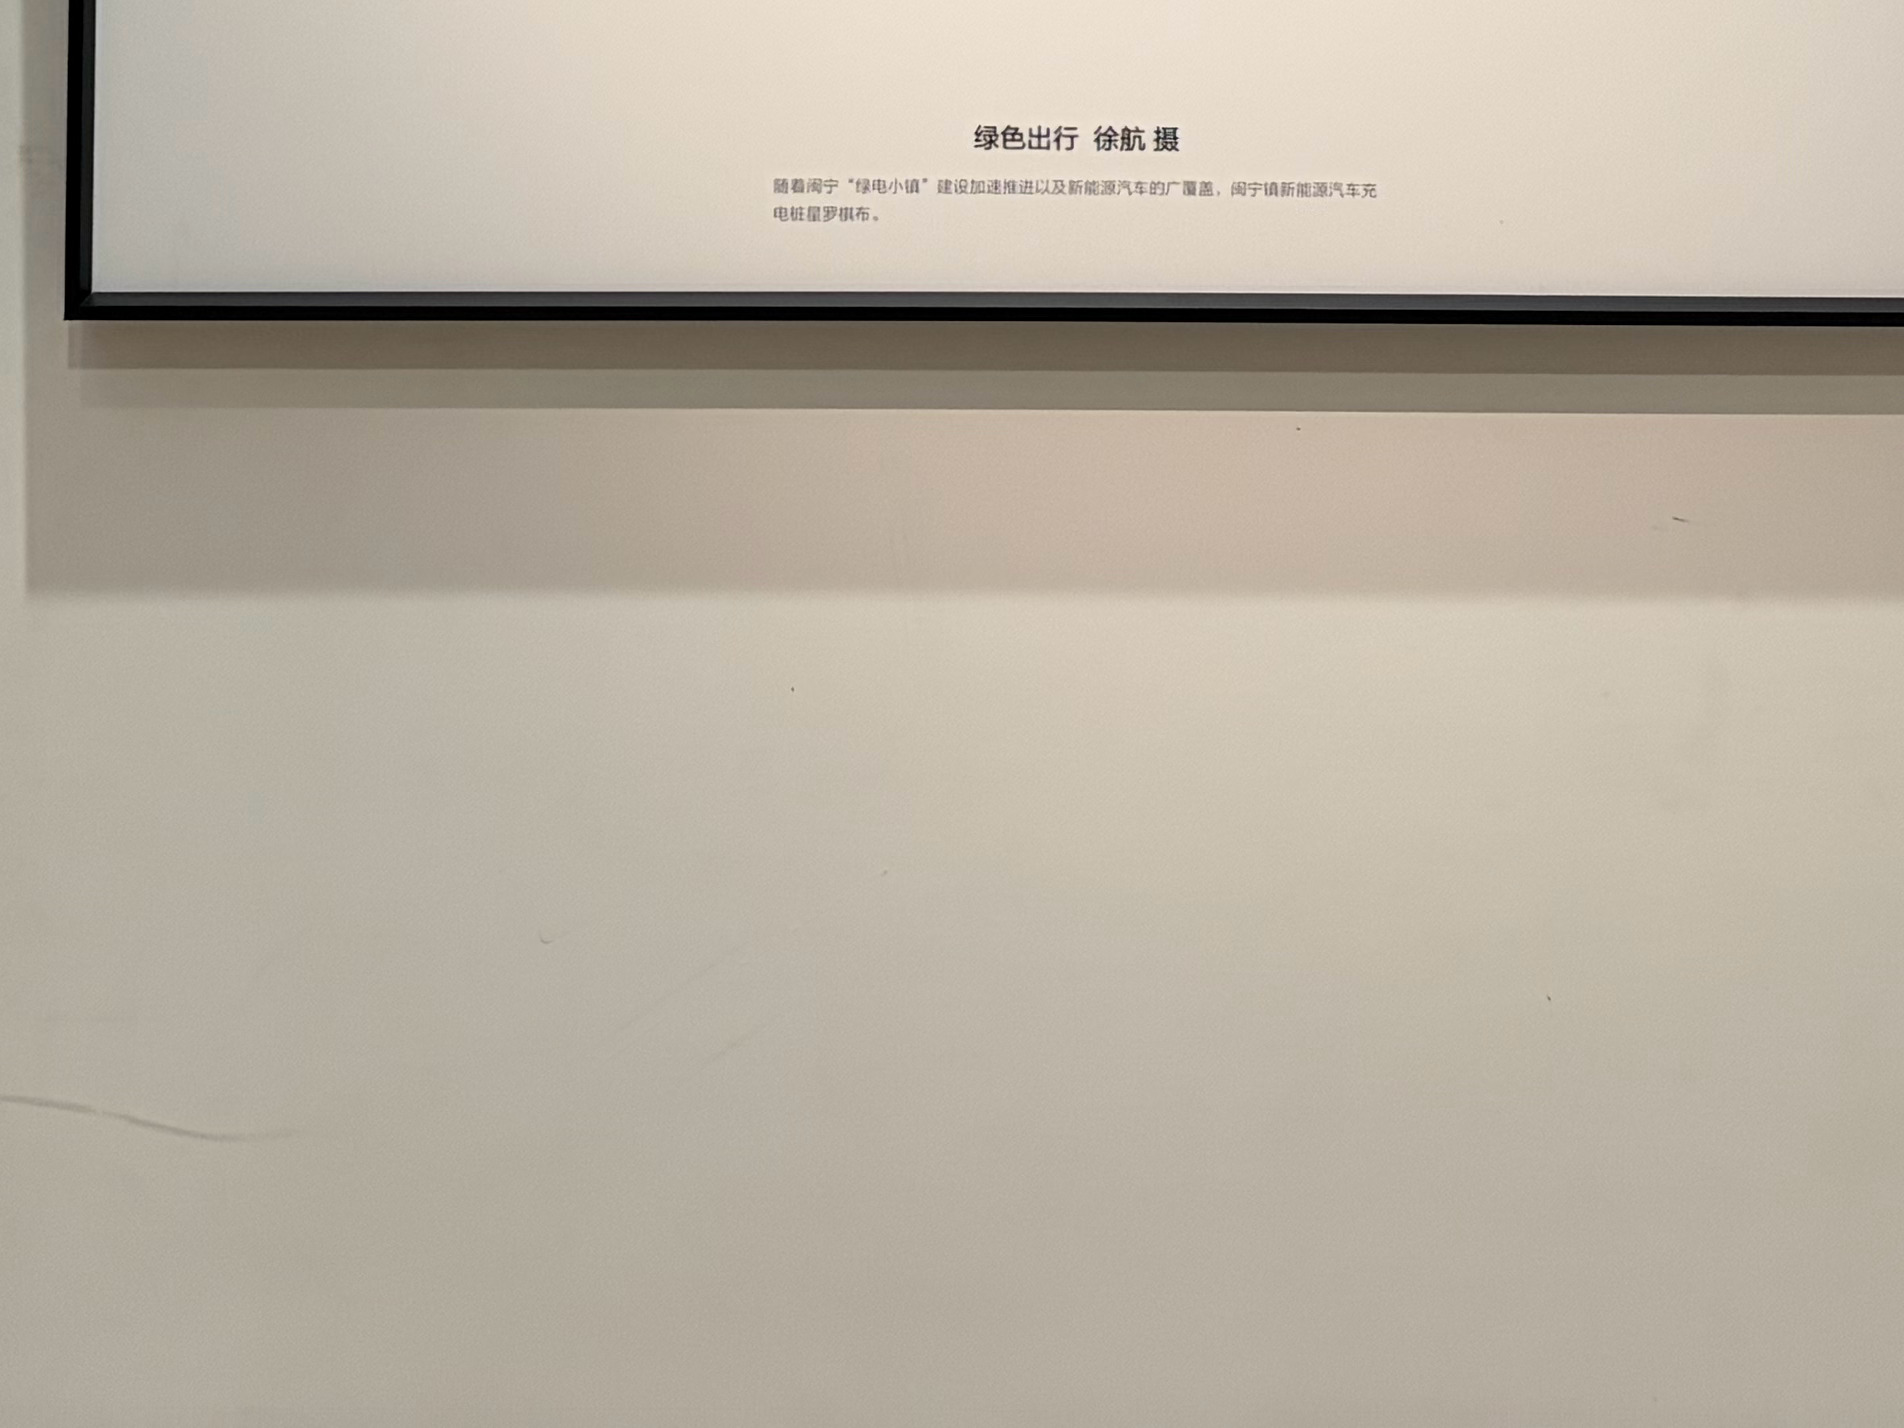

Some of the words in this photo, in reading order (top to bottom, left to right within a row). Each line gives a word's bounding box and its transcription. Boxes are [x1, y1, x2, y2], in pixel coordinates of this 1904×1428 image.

[974, 125, 1080, 152] 绿色出行
[1093, 126, 1147, 153] 徐航
[1153, 126, 1180, 153] 摄
